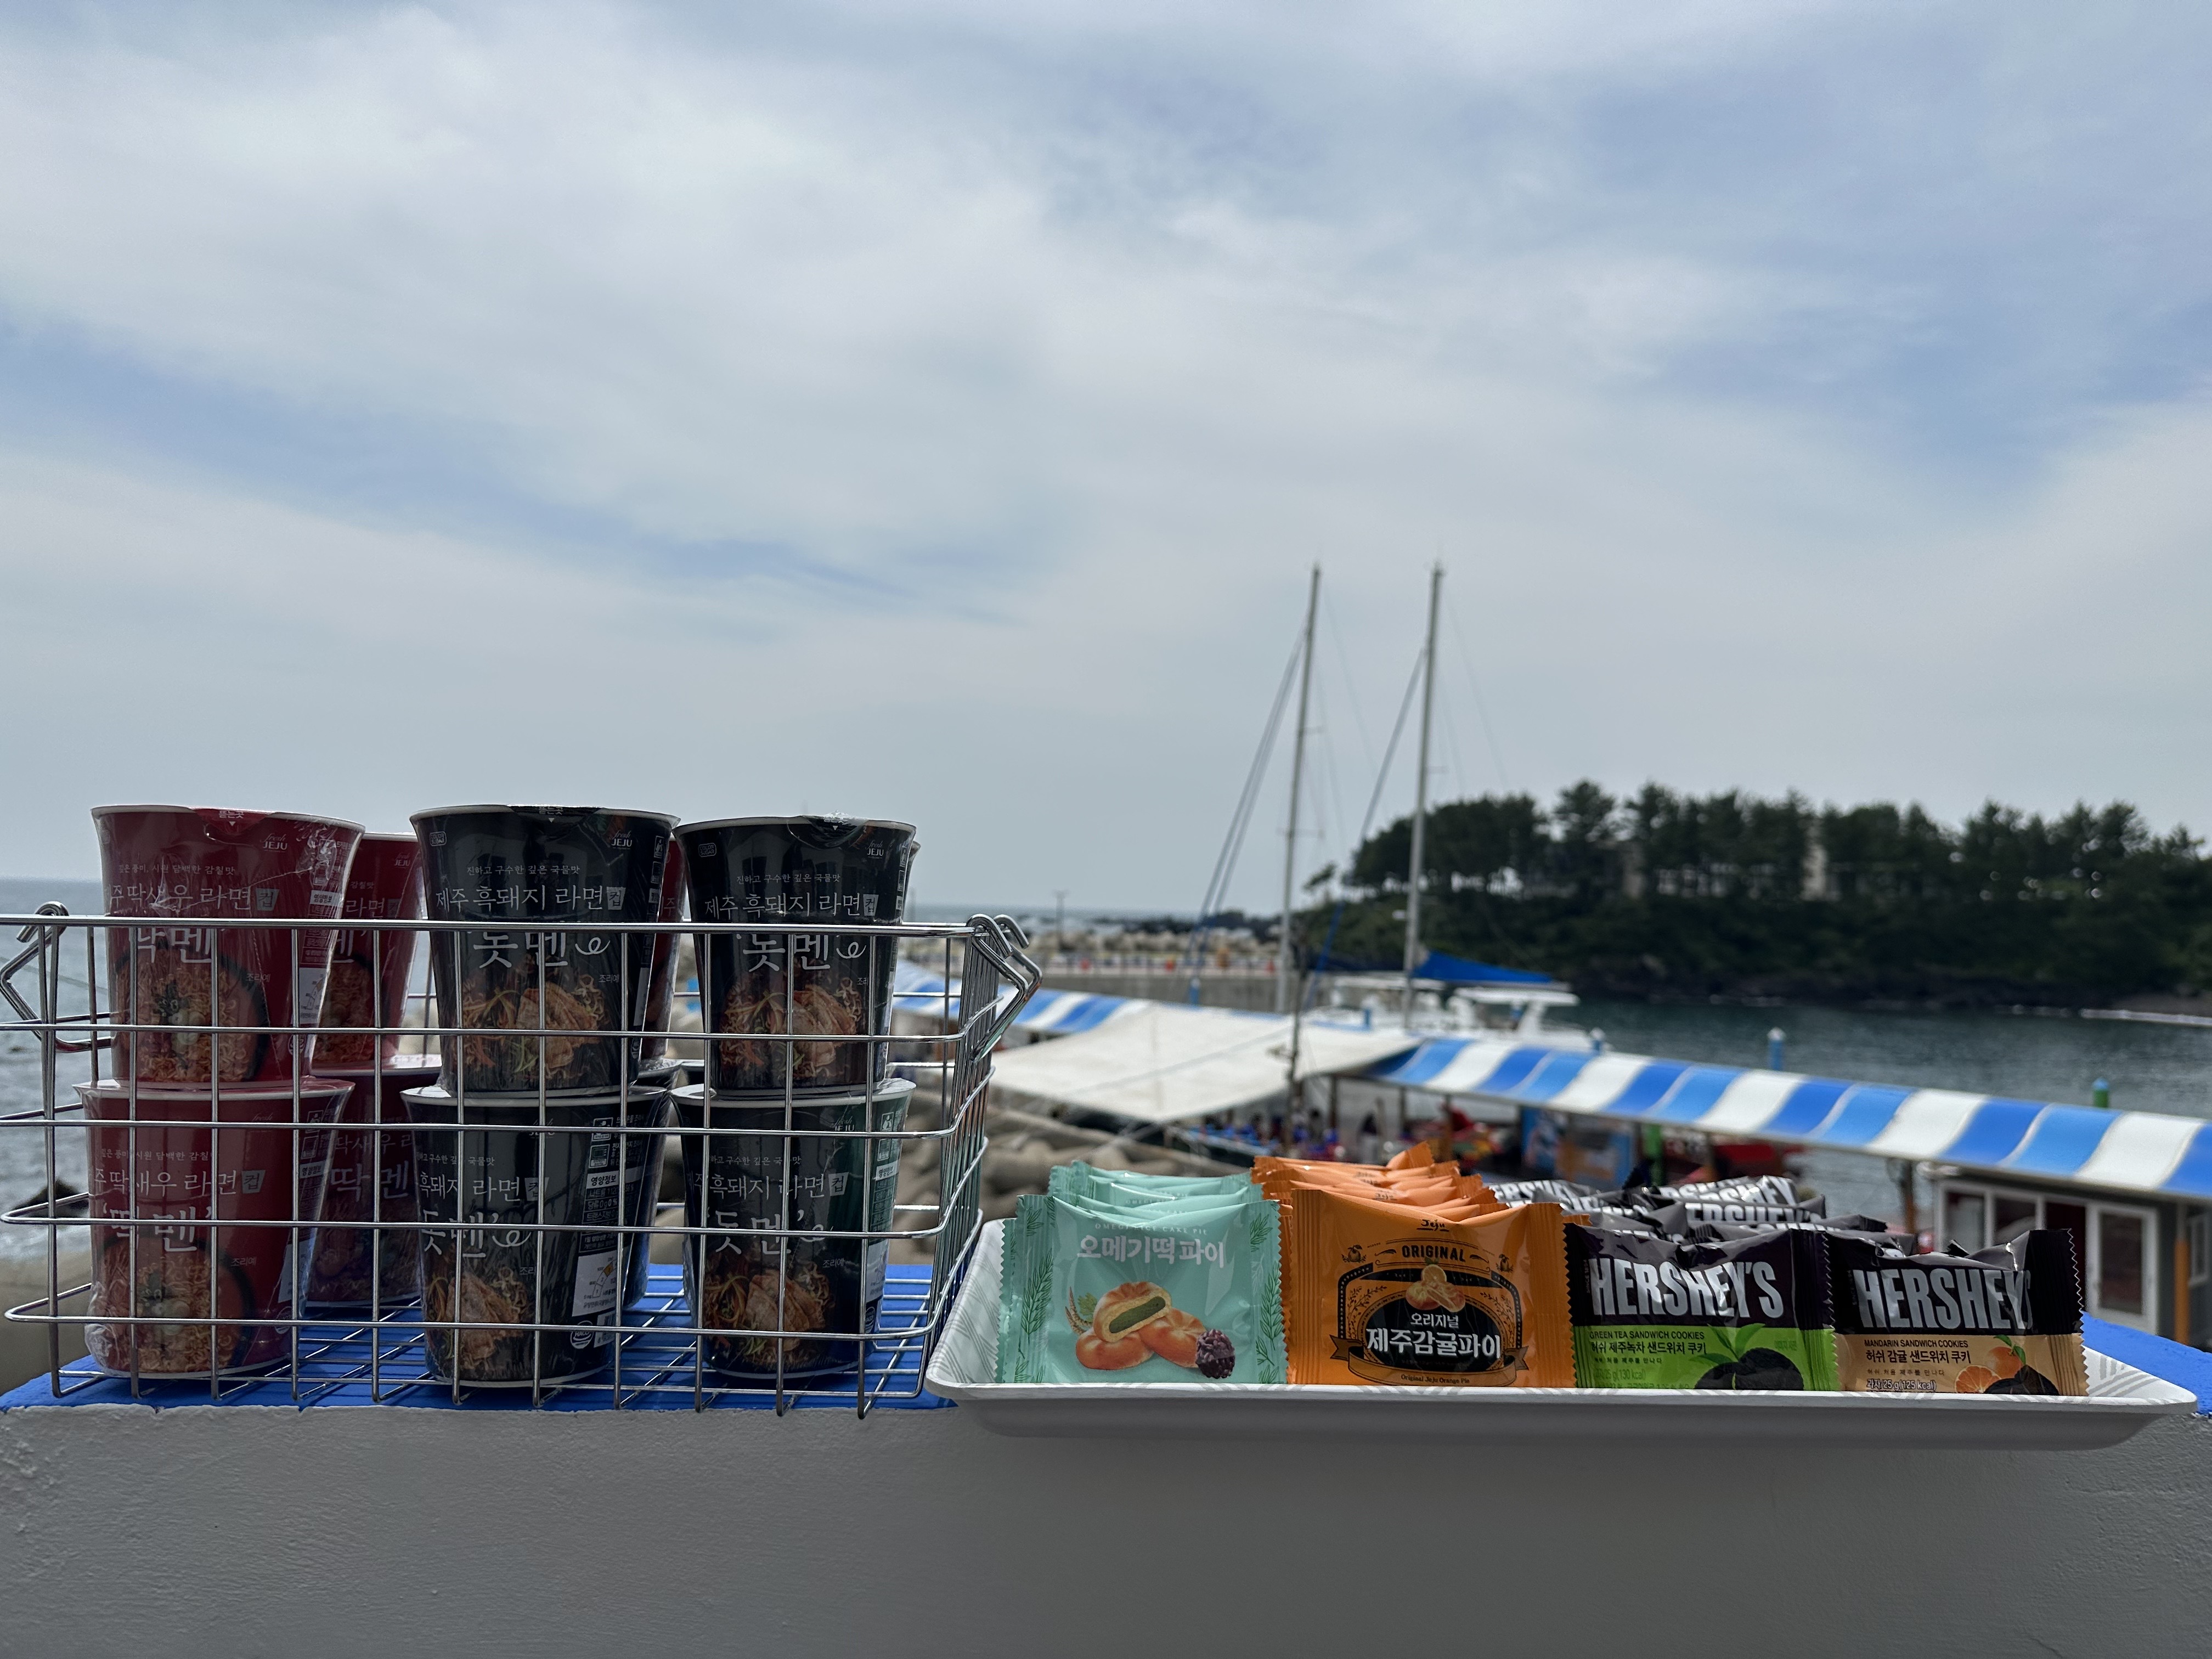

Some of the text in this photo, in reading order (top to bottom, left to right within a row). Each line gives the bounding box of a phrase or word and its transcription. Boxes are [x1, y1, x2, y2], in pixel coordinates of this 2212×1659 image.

[263, 841, 288, 850] JEJU
[867, 848, 884, 856] JEJU
[205, 865, 235, 876] 감칠맛
[467, 865, 580, 876] 진하고 구수한 깊은 국물맛
[736, 873, 841, 885] 진하고 구수한 깊은 국물맛
[127, 883, 193, 909] 딱새우
[200, 884, 251, 910] 라면
[259, 891, 273, 908] 컵
[436, 887, 469, 913] 제주
[473, 885, 545, 912] 흑돼지
[555, 884, 603, 911] 라면
[609, 889, 622, 907] 컵
[346, 897, 385, 918] 라면
[704, 892, 876, 920] 제주 흑돼지 라면 컵
[246, 973, 270, 983] 조리예
[156, 1152, 185, 1161] 담백한
[726, 1156, 751, 1166] 구수한
[753, 1156, 771, 1166] 깊은
[184, 1170, 236, 1196] 라면
[243, 1172, 259, 1190] 컵
[591, 1175, 617, 1187] 영양정보
[710, 1173, 770, 1200] 흑돼지
[831, 1175, 844, 1193] 컵
[473, 1176, 521, 1202] 라면
[1420, 1218, 1446, 1232] Jeju
[1402, 1245, 1466, 1262] ORIGINAL
[230, 1256, 257, 1267] 조리예
[1588, 1257, 1784, 1318] HERSHEY'S
[1410, 1312, 1459, 1329] 오리지널
[1589, 1330, 1705, 1340] GREEN TEA SANDWICH COOKIES
[1365, 1328, 1502, 1359] 제주감귤파이
[1609, 1341, 1645, 1354] 제주녹차
[1647, 1342, 1685, 1355] 샌드위치
[1688, 1342, 1707, 1355] 쿠키
[1864, 1339, 1899, 1347] MANDARIN
[1938, 1340, 1968, 1348] COOKIES
[1866, 1350, 1971, 1364] 허쉬 감귤 샌드위치 쿠키
[1401, 1374, 1424, 1383] Original
[1425, 1375, 1438, 1384] Jeju
[1439, 1376, 1460, 1385] Orange
[1866, 1378, 1893, 1390] 과자/25
[1917, 1380, 1937, 1391] kcal)
